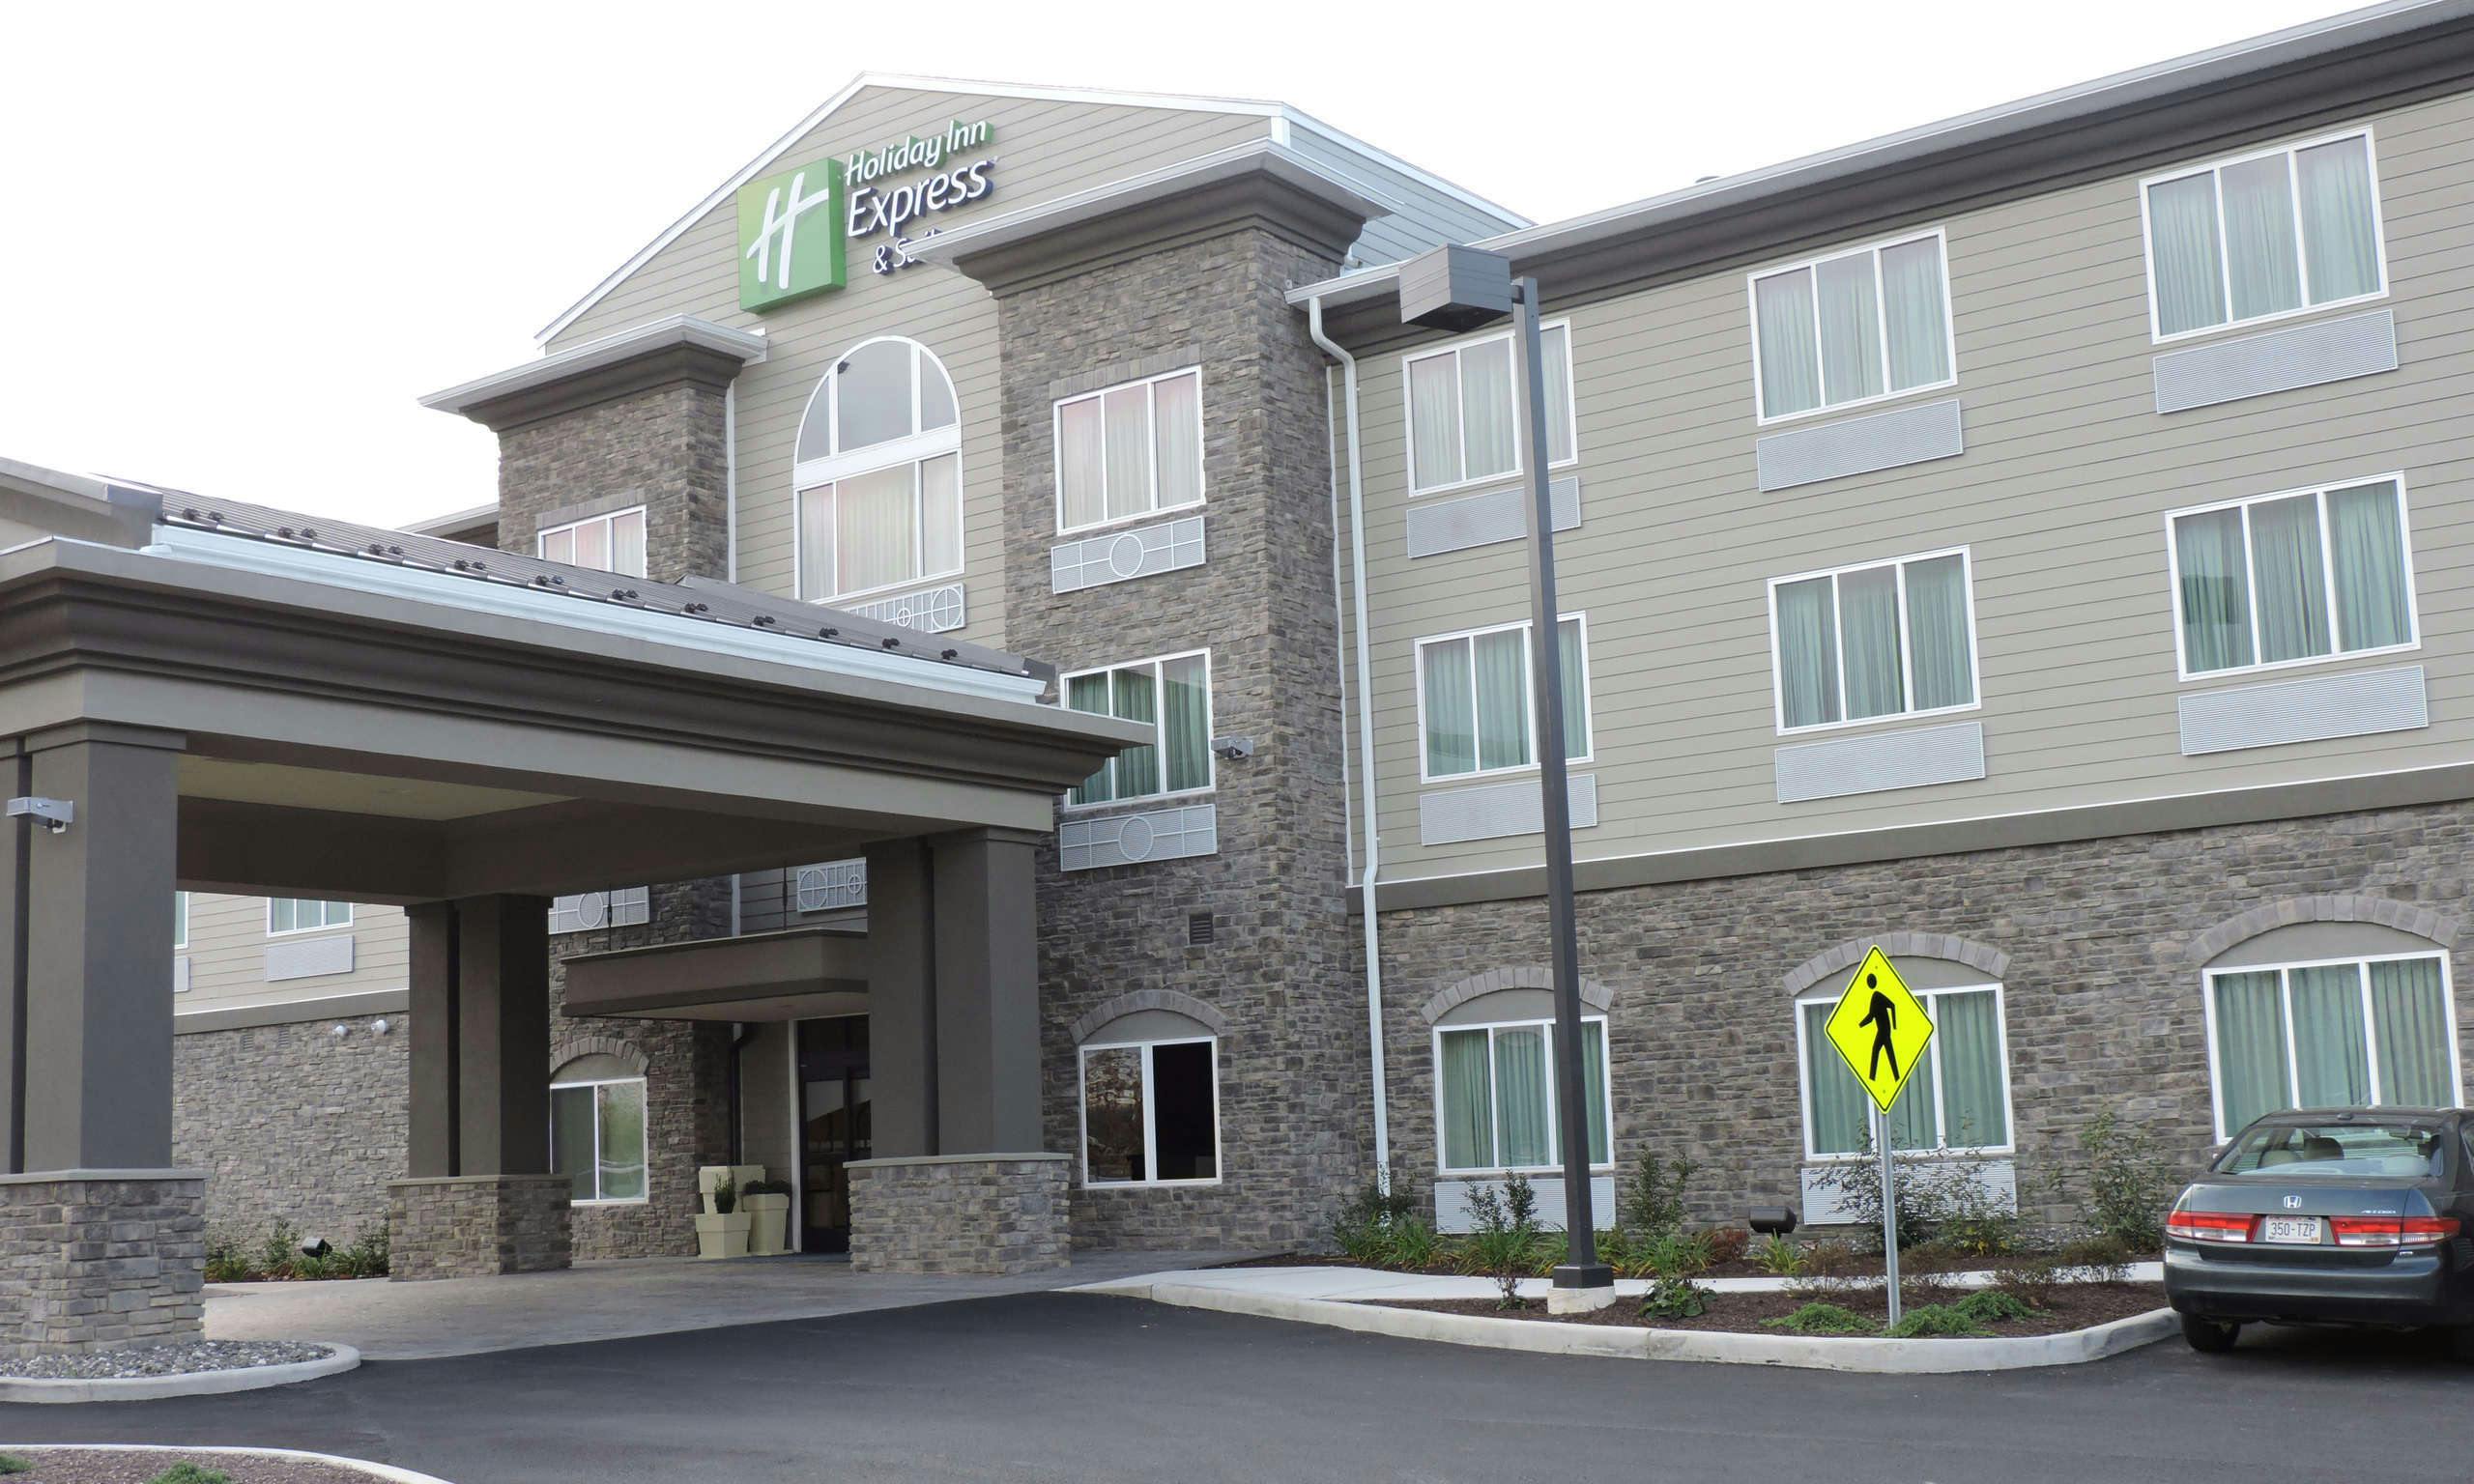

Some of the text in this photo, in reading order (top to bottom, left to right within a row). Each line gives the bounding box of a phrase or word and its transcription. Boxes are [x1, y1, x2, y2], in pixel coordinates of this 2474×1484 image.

[844, 119, 988, 186] Holiday Inn
[848, 159, 989, 237] Express
[873, 244, 888, 273] &
[2270, 1221, 2316, 1237] 350-TZP
